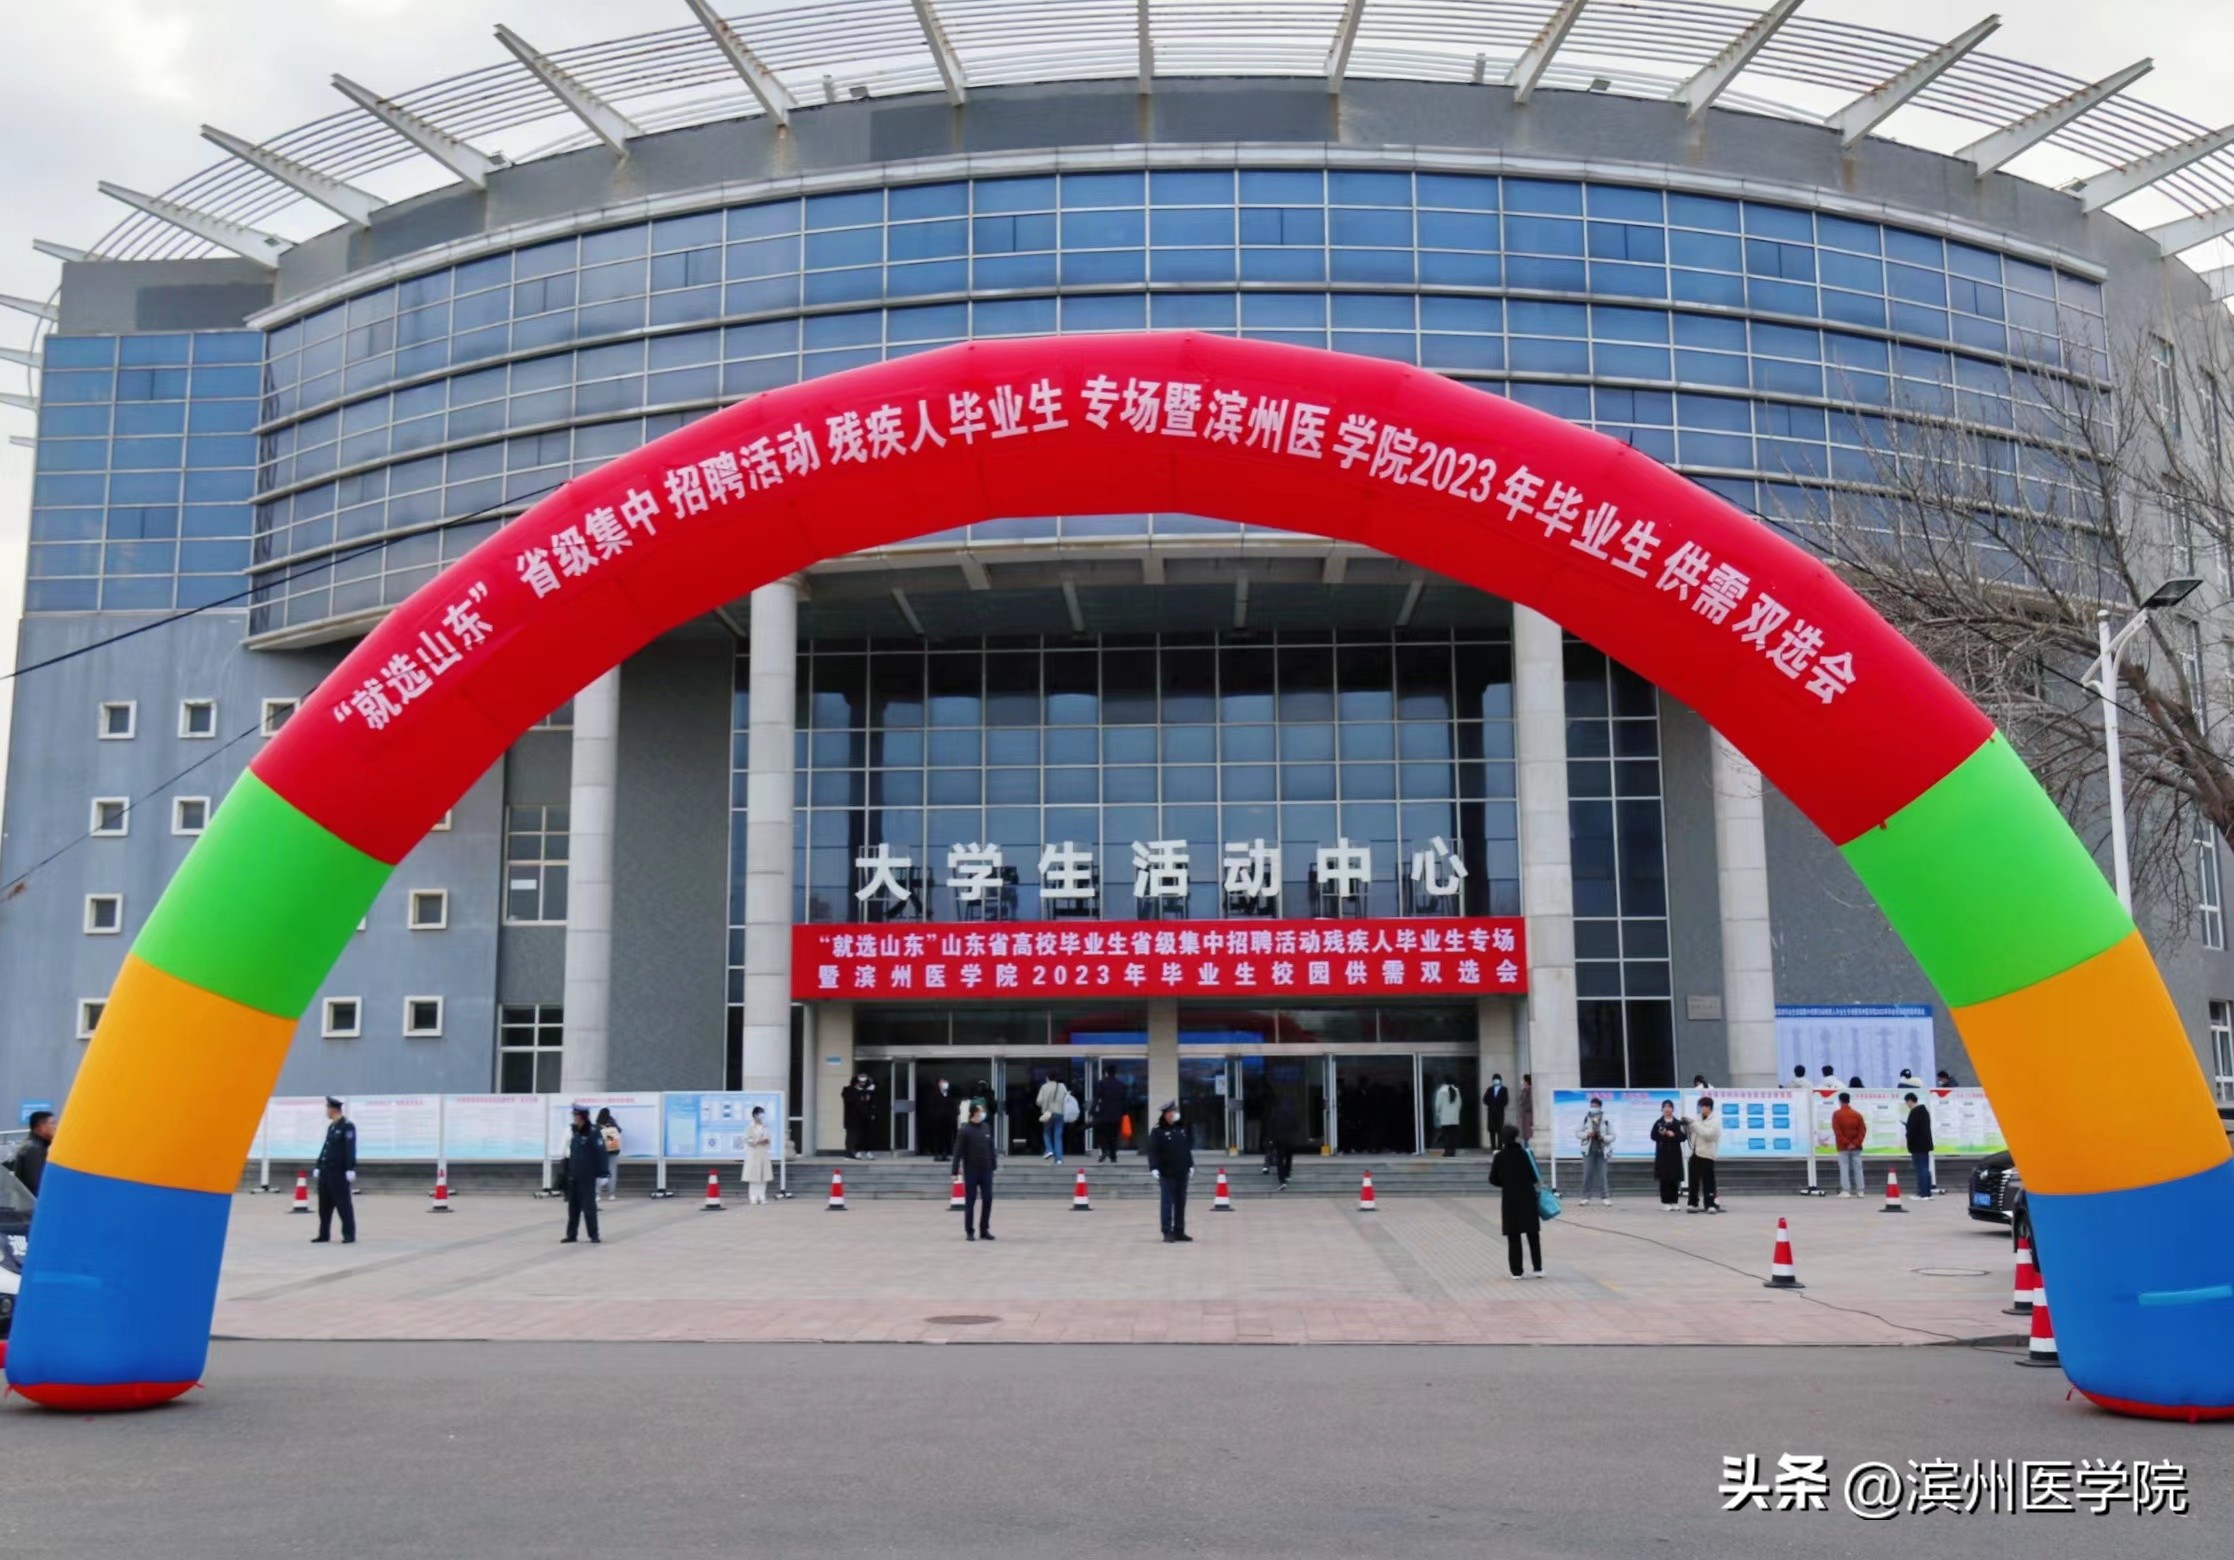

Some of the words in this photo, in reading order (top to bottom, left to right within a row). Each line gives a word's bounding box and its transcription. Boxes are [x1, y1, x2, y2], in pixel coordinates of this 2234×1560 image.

[856, 837, 1467, 900] 大学生活动中心
